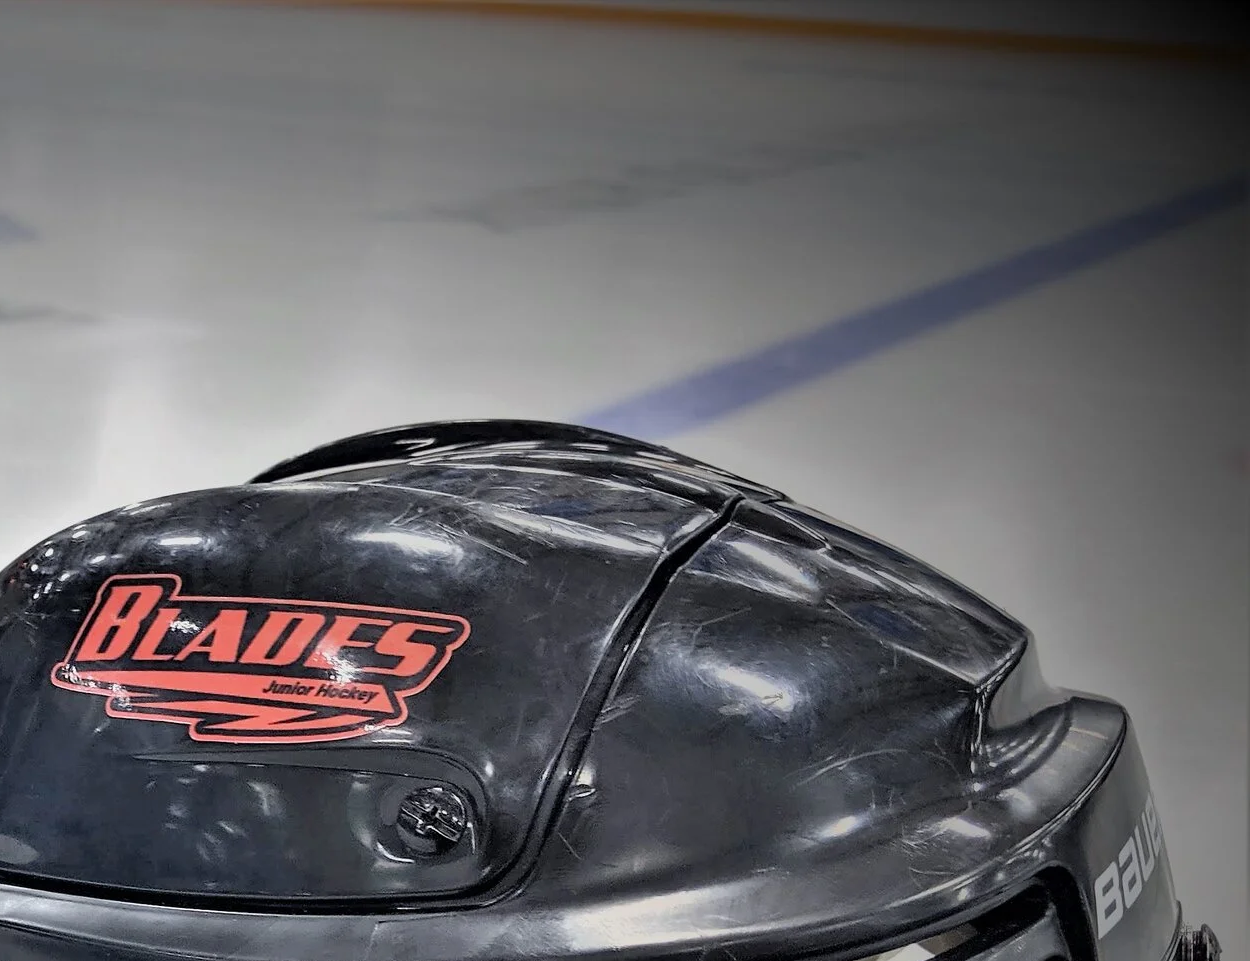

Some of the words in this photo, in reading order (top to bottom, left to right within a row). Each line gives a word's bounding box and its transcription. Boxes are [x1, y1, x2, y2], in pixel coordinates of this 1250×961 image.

[75, 585, 455, 676] BLADES
[262, 680, 314, 696] Junior
[315, 683, 379, 704] Hockey
